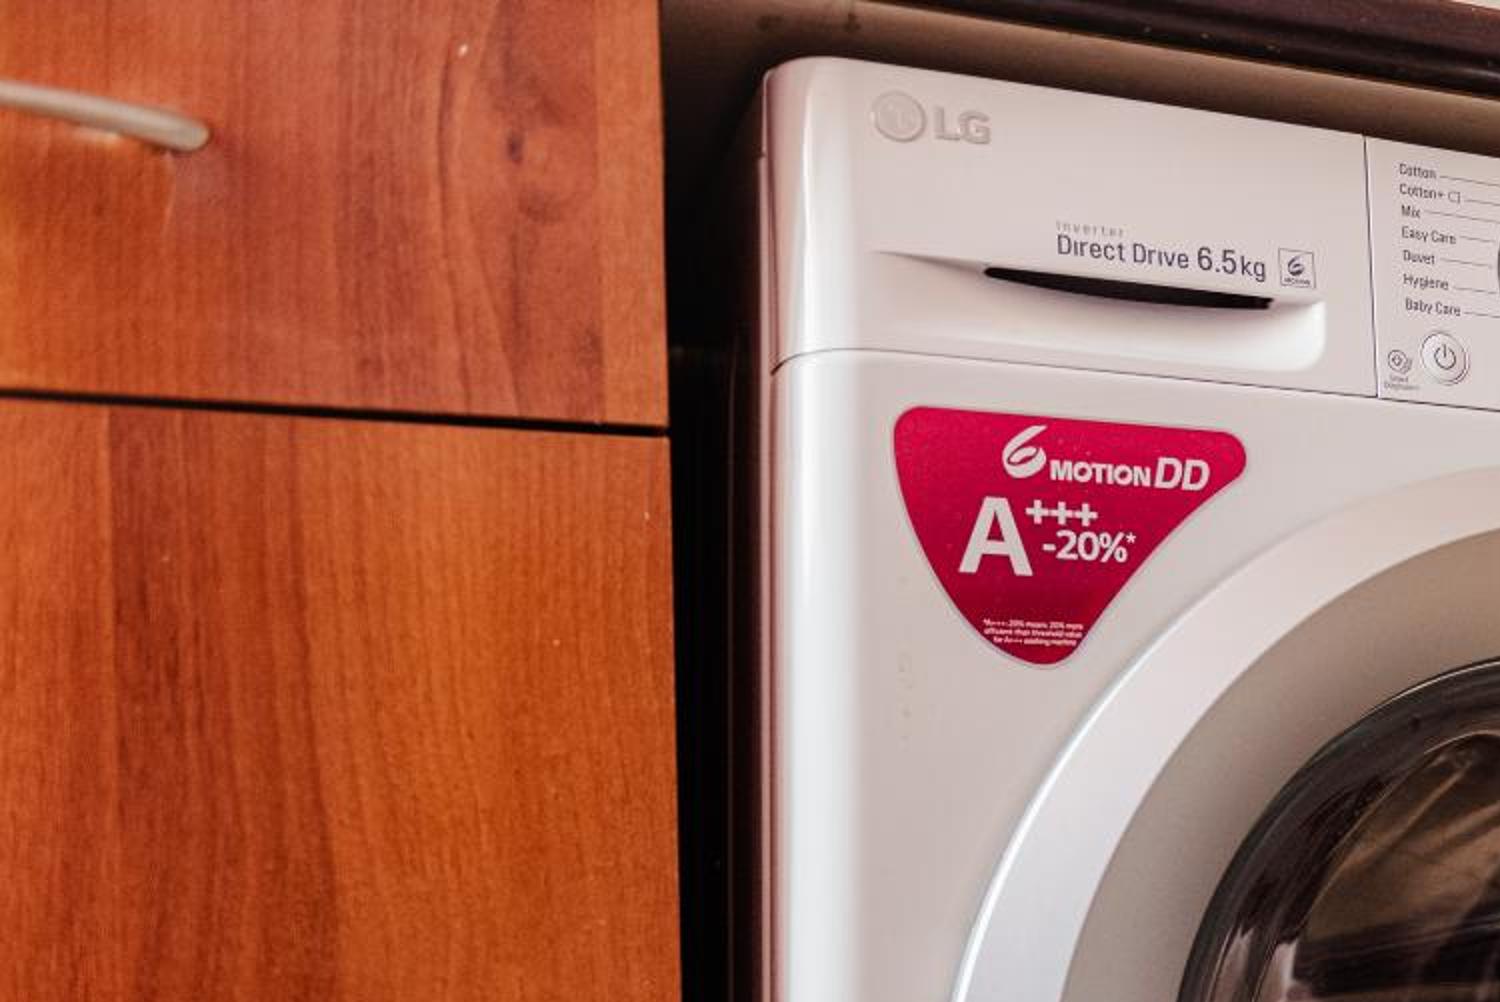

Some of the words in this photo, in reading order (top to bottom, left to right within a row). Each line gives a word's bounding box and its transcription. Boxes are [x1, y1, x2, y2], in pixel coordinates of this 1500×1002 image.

[933, 105, 991, 144] LG
[1399, 163, 1437, 179] Cotton
[1401, 204, 1421, 218] Mix
[1401, 225, 1429, 243] Easy
[1431, 230, 1456, 245] Care
[1057, 234, 1126, 262] Direct
[1132, 242, 1189, 268] Drive
[1197, 246, 1266, 282] 6.5kg
[1403, 249, 1435, 264] Duvet
[1403, 273, 1449, 290] Hygiene
[1405, 297, 1433, 314] Baby
[1435, 301, 1461, 316] Care
[1002, 425, 1047, 478] 6
[1050, 459, 1151, 487] MOTION
[1154, 456, 1210, 491] DD
